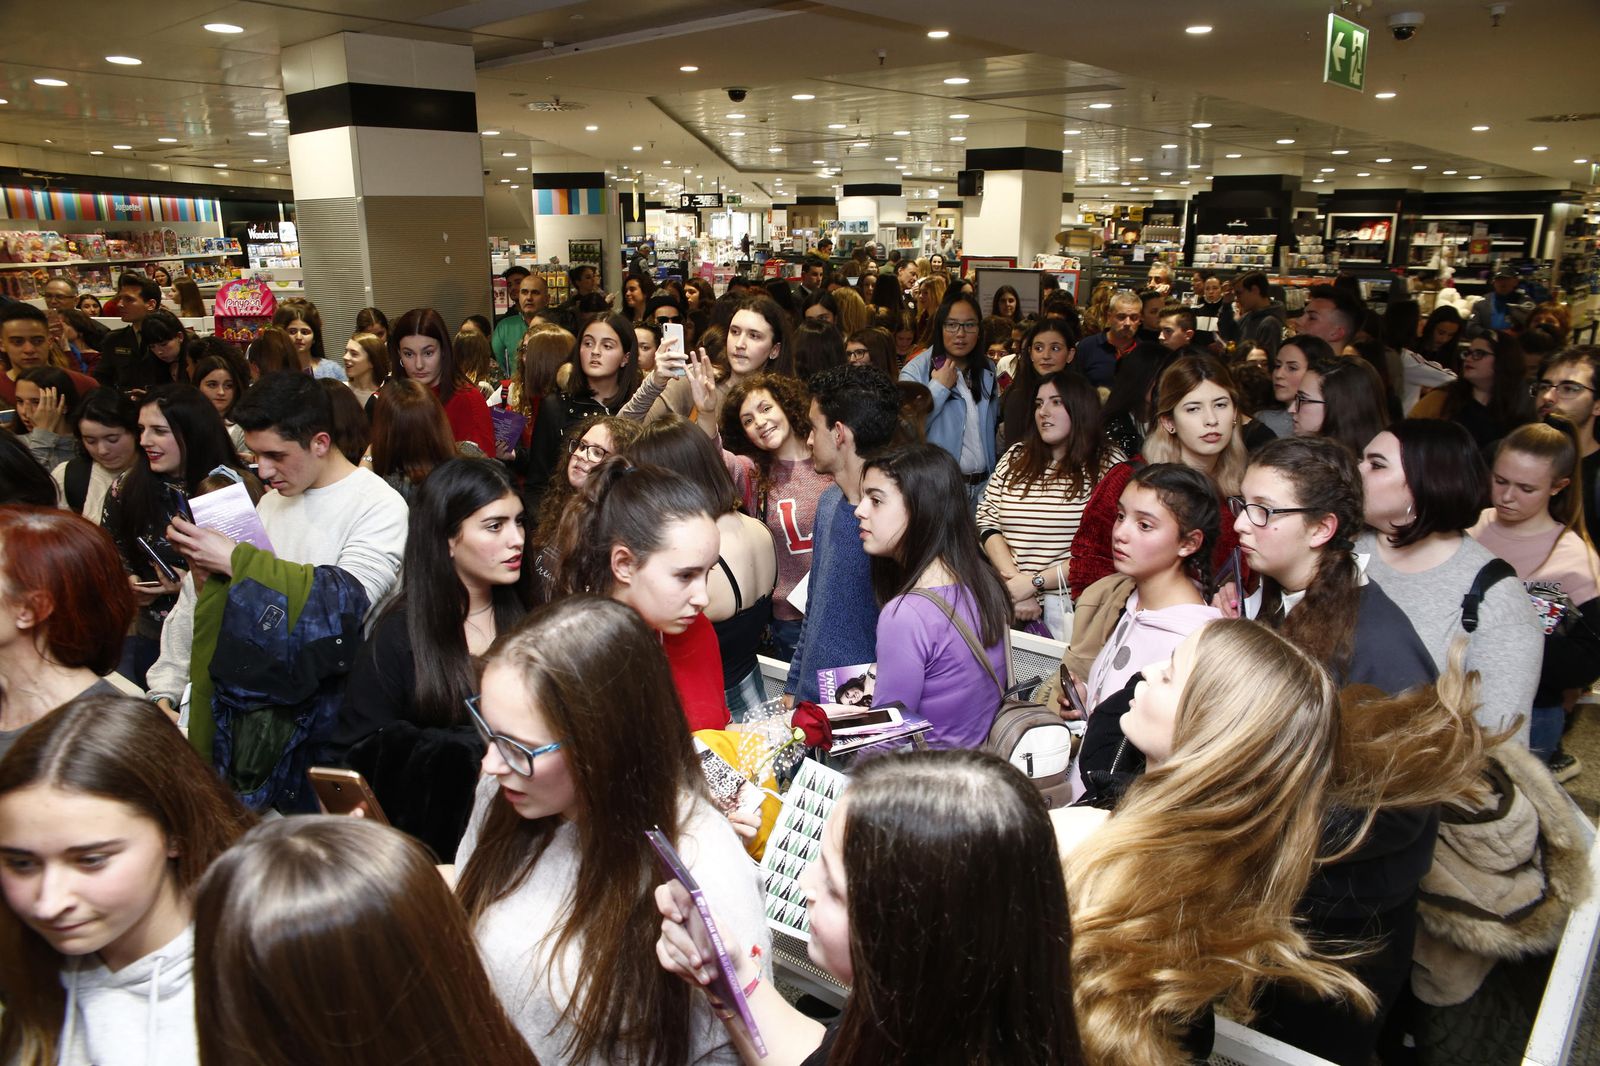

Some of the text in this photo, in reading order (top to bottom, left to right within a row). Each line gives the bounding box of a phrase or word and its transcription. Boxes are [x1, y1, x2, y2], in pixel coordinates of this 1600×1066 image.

[115, 202, 142, 213] Juguetes
[682, 196, 689, 207] B
[247, 227, 279, 239] Wonderbox
[778, 499, 814, 555] L
[818, 670, 829, 701] JULIA
[825, 669, 837, 704] EDINA
[705, 917, 717, 933] JULIA
[711, 932, 726, 957] MEDINA
